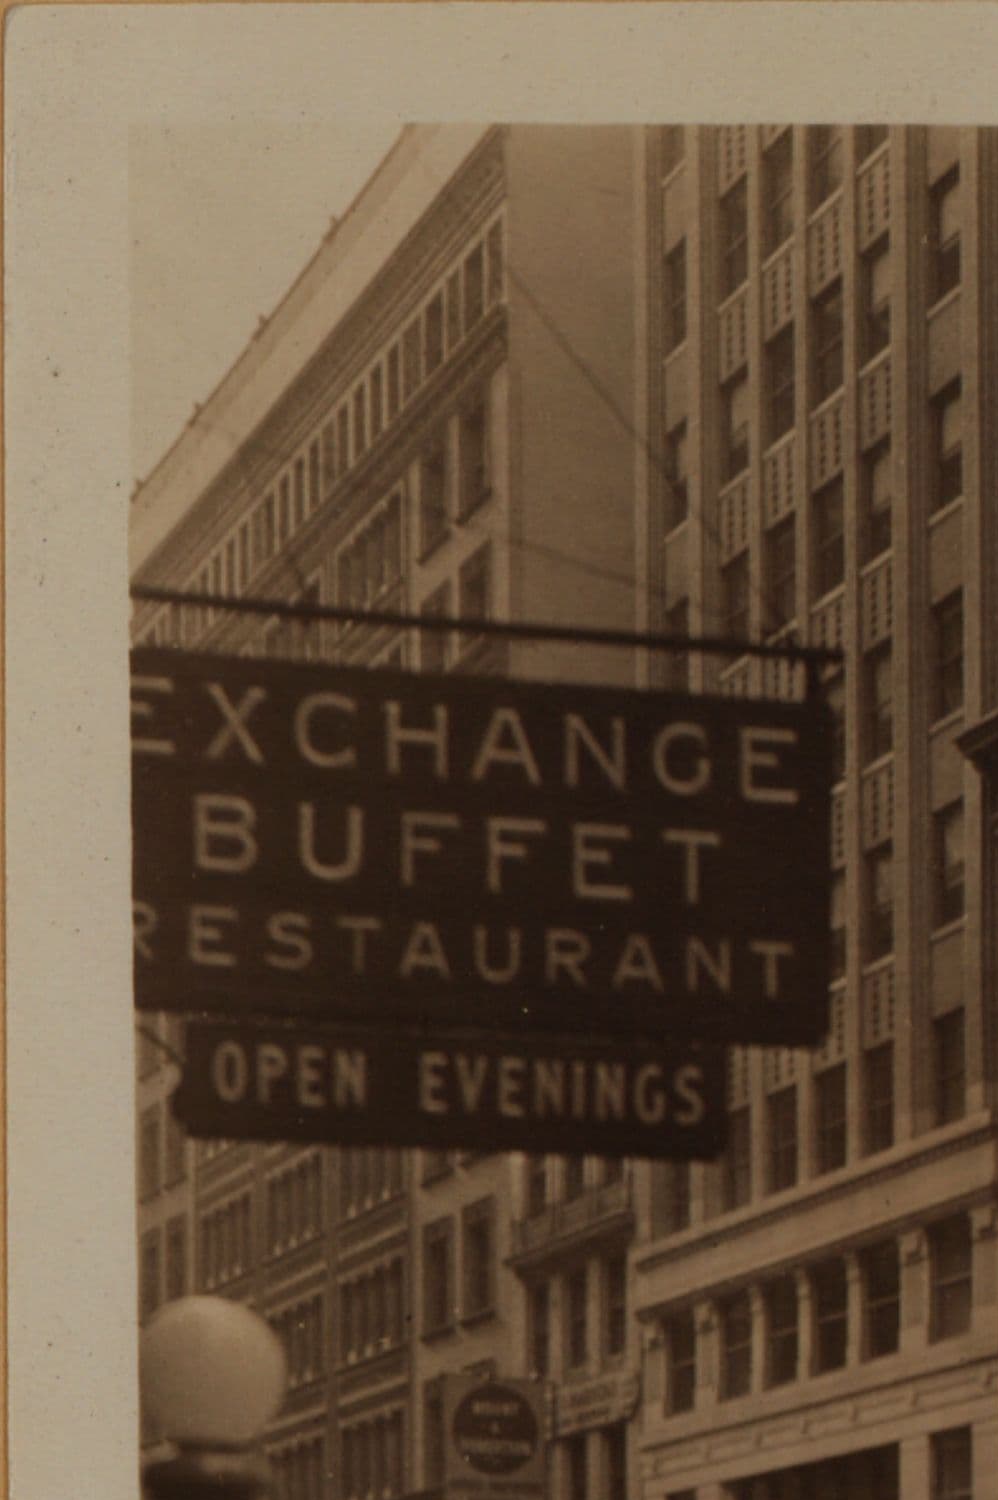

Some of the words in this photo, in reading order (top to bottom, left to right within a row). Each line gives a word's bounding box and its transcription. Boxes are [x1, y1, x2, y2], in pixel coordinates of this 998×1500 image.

[130, 675, 799, 803] EXCHANGE
[192, 793, 722, 904] BUFFET
[131, 900, 795, 999] RESTAURANT
[211, 1038, 367, 1106] OPEN
[417, 1051, 706, 1124] EVENINGS
